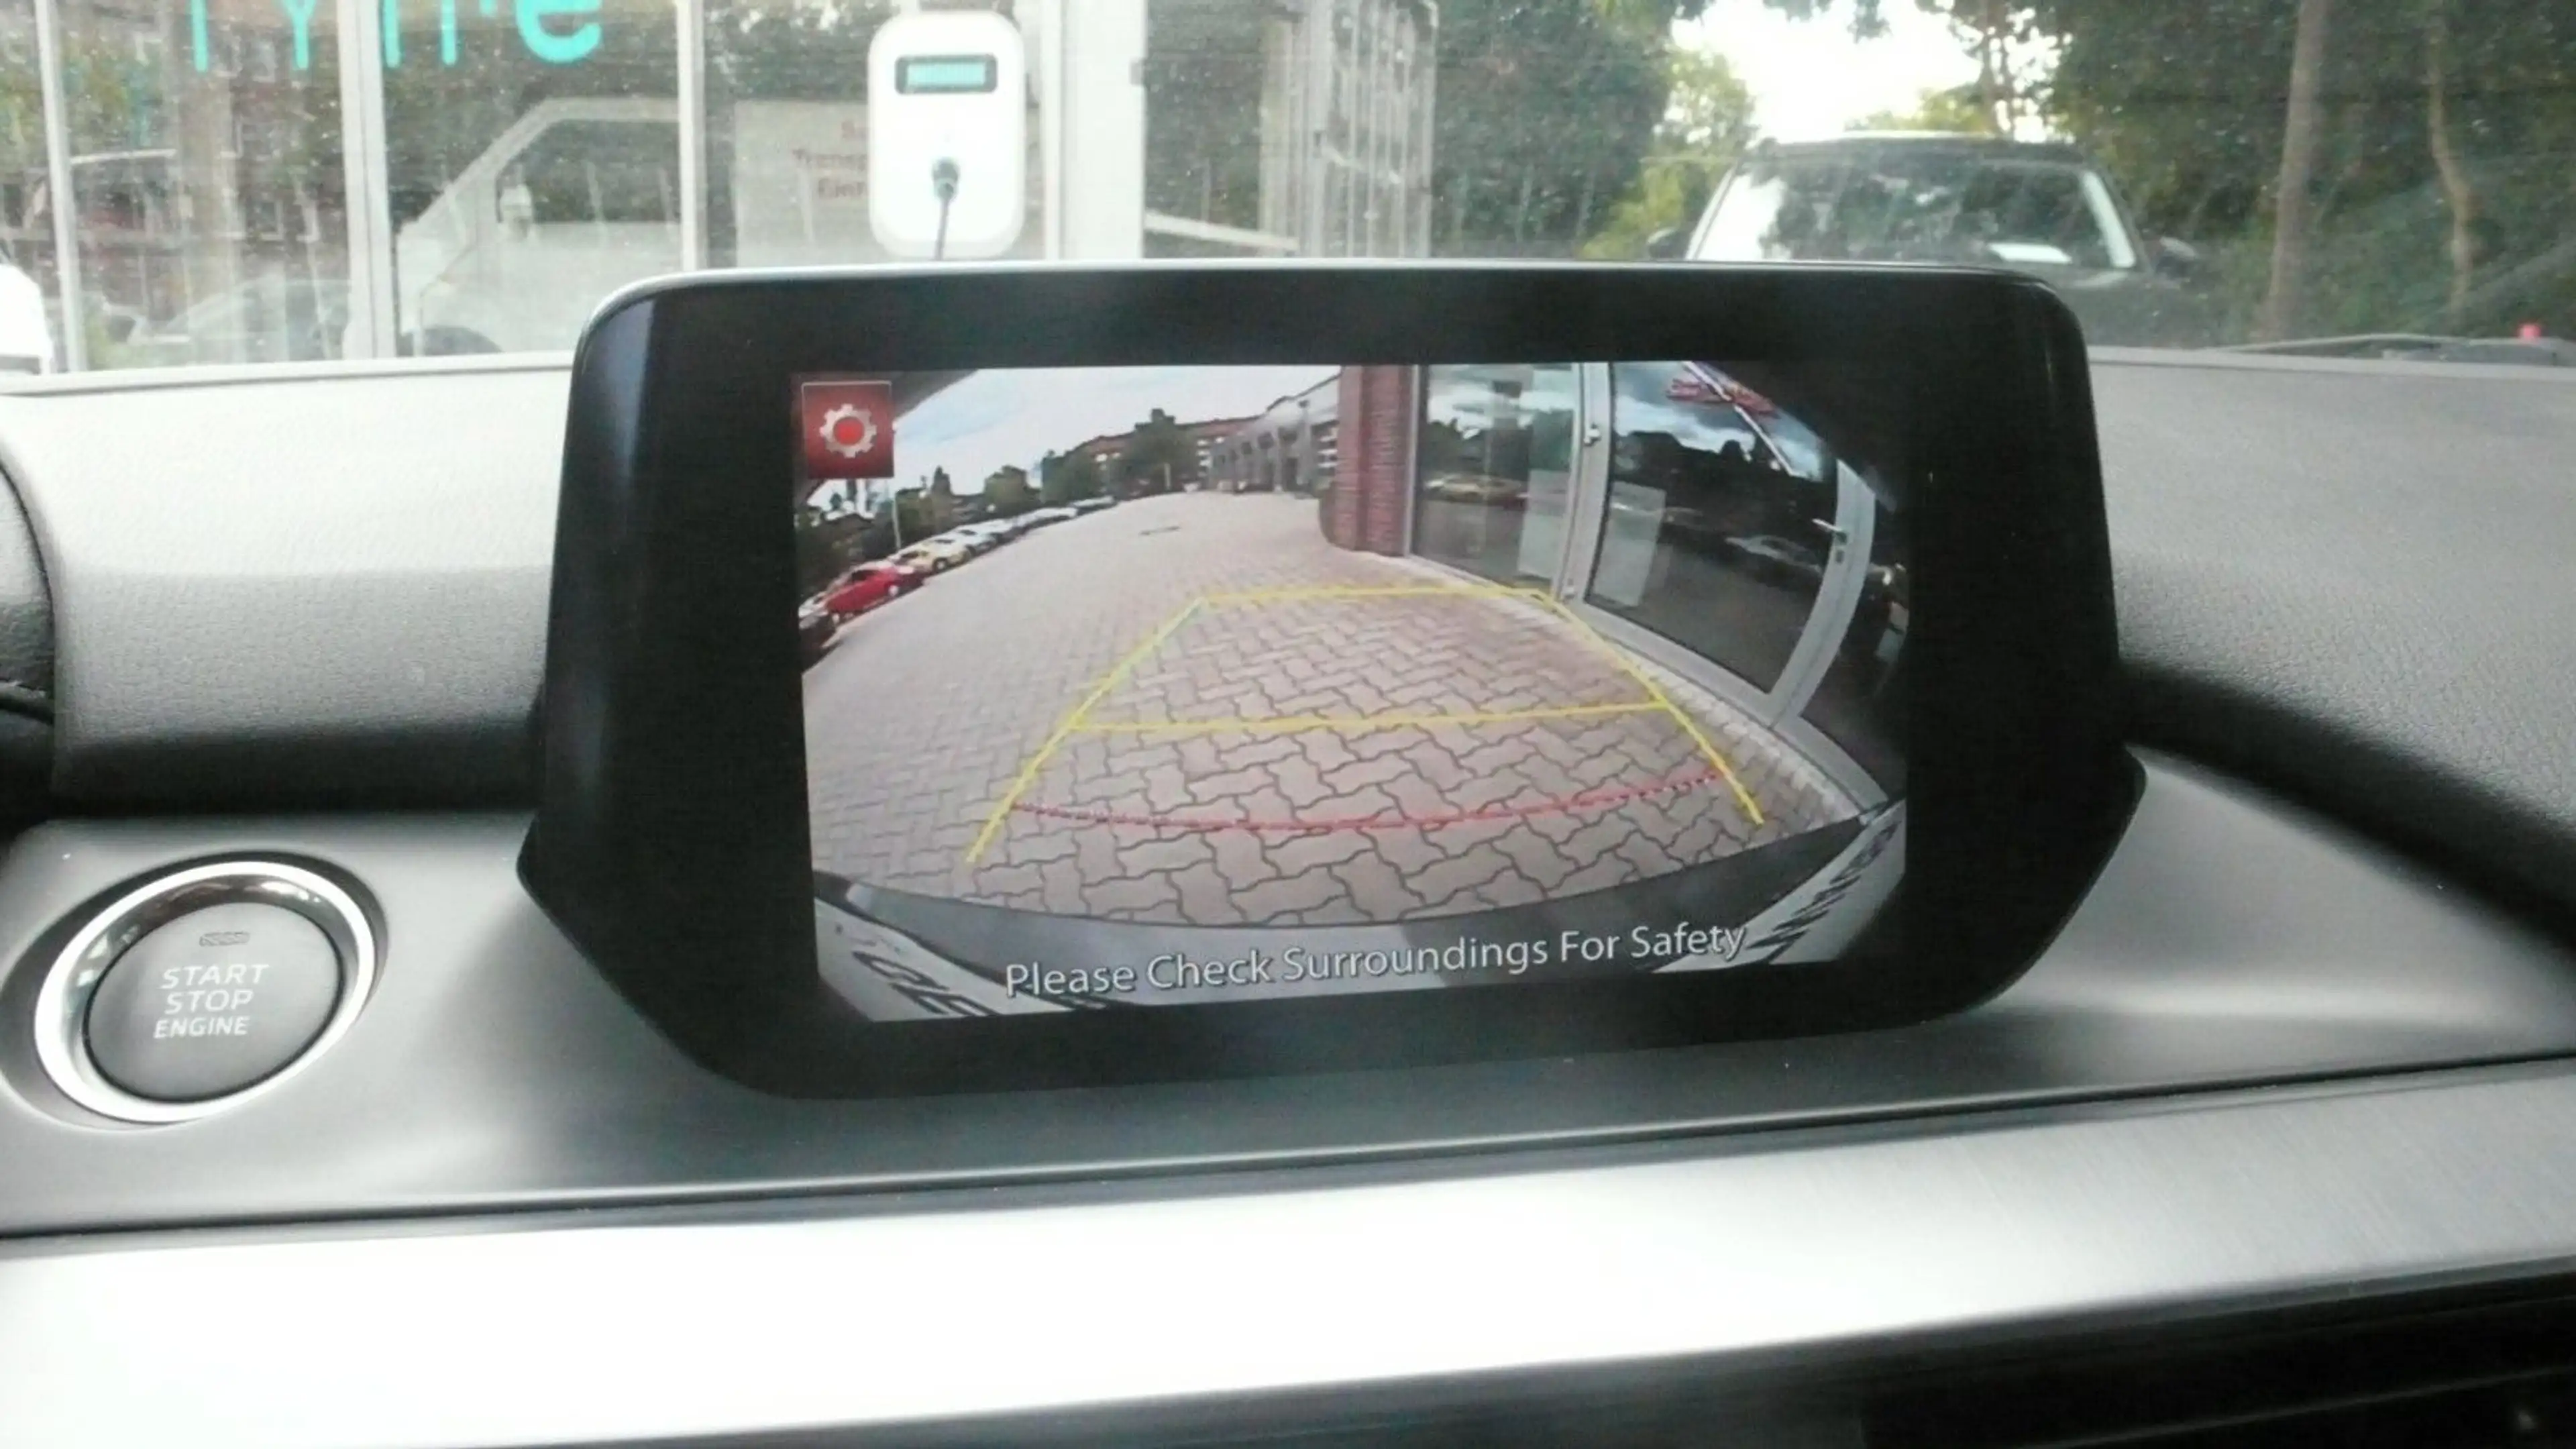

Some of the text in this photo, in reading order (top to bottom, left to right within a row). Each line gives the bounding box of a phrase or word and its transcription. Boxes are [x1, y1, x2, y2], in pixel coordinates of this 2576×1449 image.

[1006, 961, 1135, 997] Please
[1147, 949, 1275, 988] Check
[1283, 936, 1547, 981] Surroundings
[1561, 930, 1619, 962] For
[1631, 922, 1746, 959] Safety
[160, 963, 270, 989] START
[164, 989, 253, 1014] STOP
[154, 1016, 250, 1038] ENGINE
